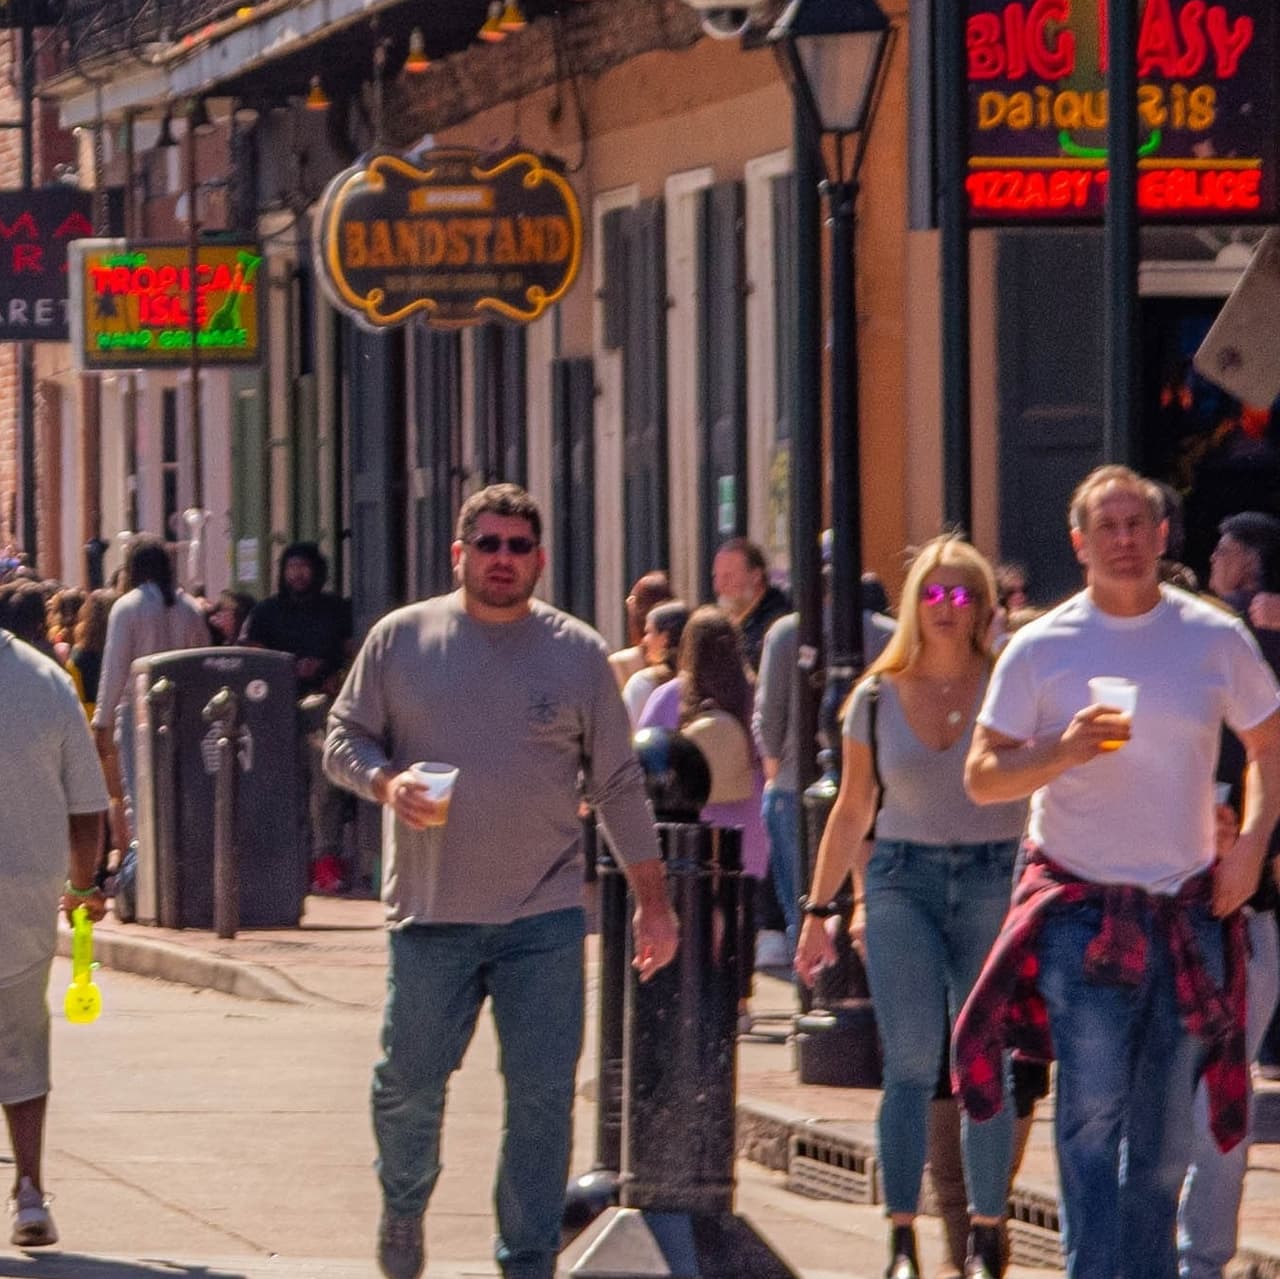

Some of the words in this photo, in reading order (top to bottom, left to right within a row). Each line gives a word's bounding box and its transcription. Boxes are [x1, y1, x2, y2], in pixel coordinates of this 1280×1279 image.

[1049, 170, 1093, 208] BY
[345, 217, 571, 267] BANDSTAND
[91, 263, 252, 296] TROPICAL
[139, 295, 208, 327] ISLE
